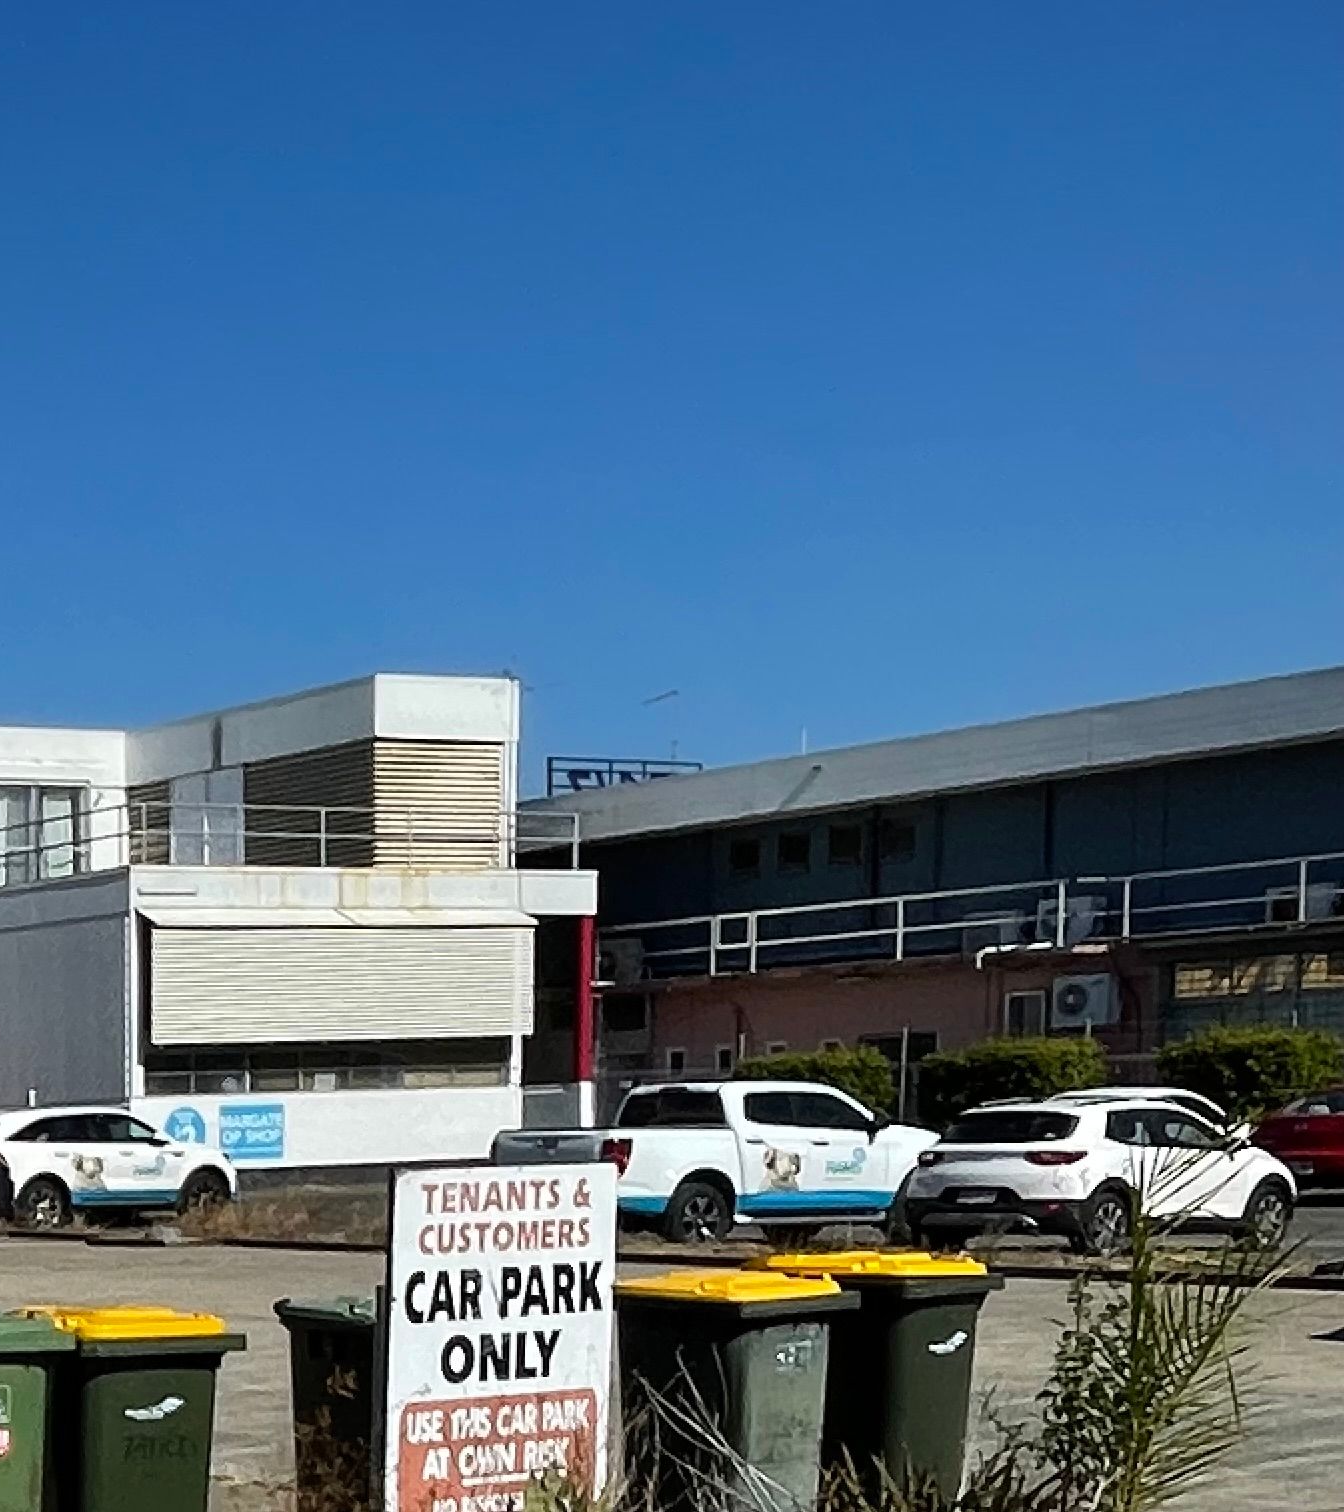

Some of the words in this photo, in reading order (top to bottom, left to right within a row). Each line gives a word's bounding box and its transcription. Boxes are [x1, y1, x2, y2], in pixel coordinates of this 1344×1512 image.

[421, 1179, 560, 1215] TENANTS
[573, 1177, 592, 1209] &
[418, 1217, 590, 1255] CUSTOMERS
[404, 1268, 483, 1324] CAR
[499, 1260, 604, 1320] PARK
[440, 1329, 562, 1384] ONLY
[406, 1410, 444, 1444] USE
[450, 1406, 492, 1441] THIS
[496, 1402, 538, 1436] CAR
[542, 1398, 590, 1431] PARK
[422, 1447, 451, 1481] AT
[458, 1442, 516, 1477] OWN
